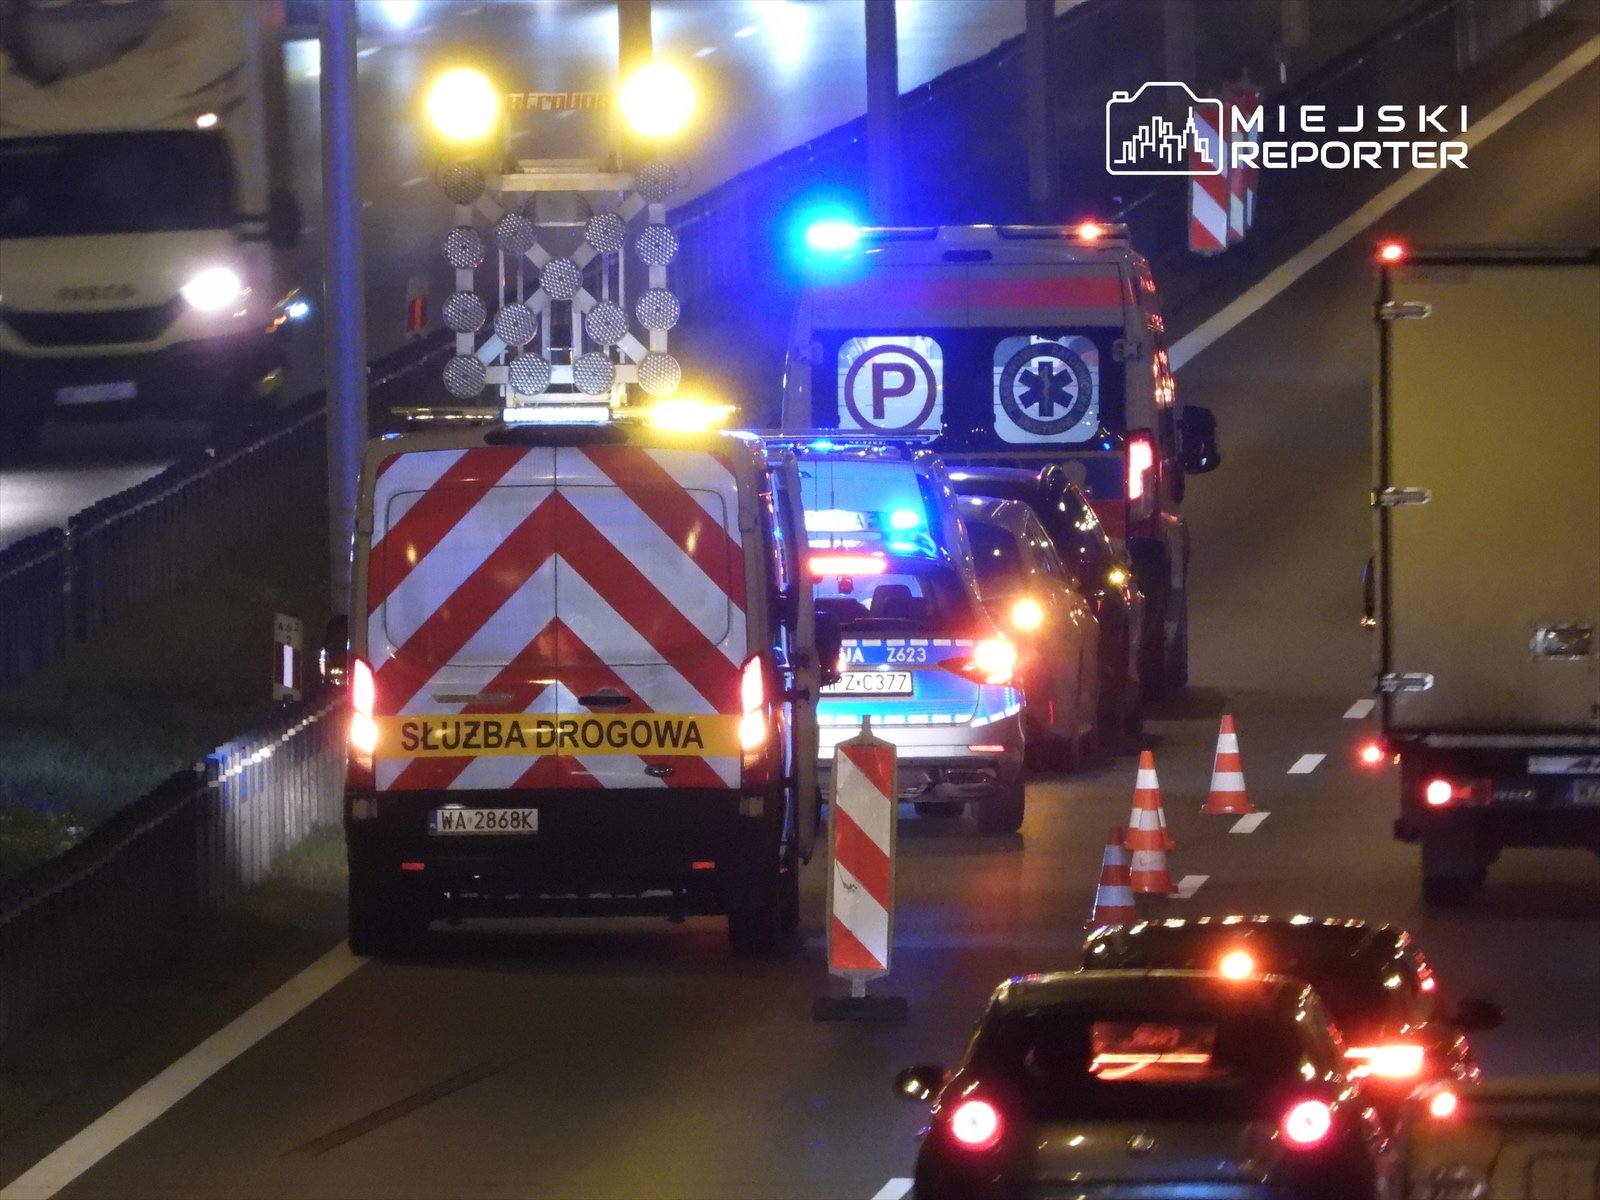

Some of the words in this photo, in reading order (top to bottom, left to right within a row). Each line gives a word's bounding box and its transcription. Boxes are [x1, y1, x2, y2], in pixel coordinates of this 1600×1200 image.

[871, 362, 917, 420] P
[887, 647, 924, 663] Z623
[863, 674, 905, 691] C377
[536, 718, 705, 749] DROGOWA
[441, 811, 467, 830] WA
[474, 811, 534, 830] 2868K
